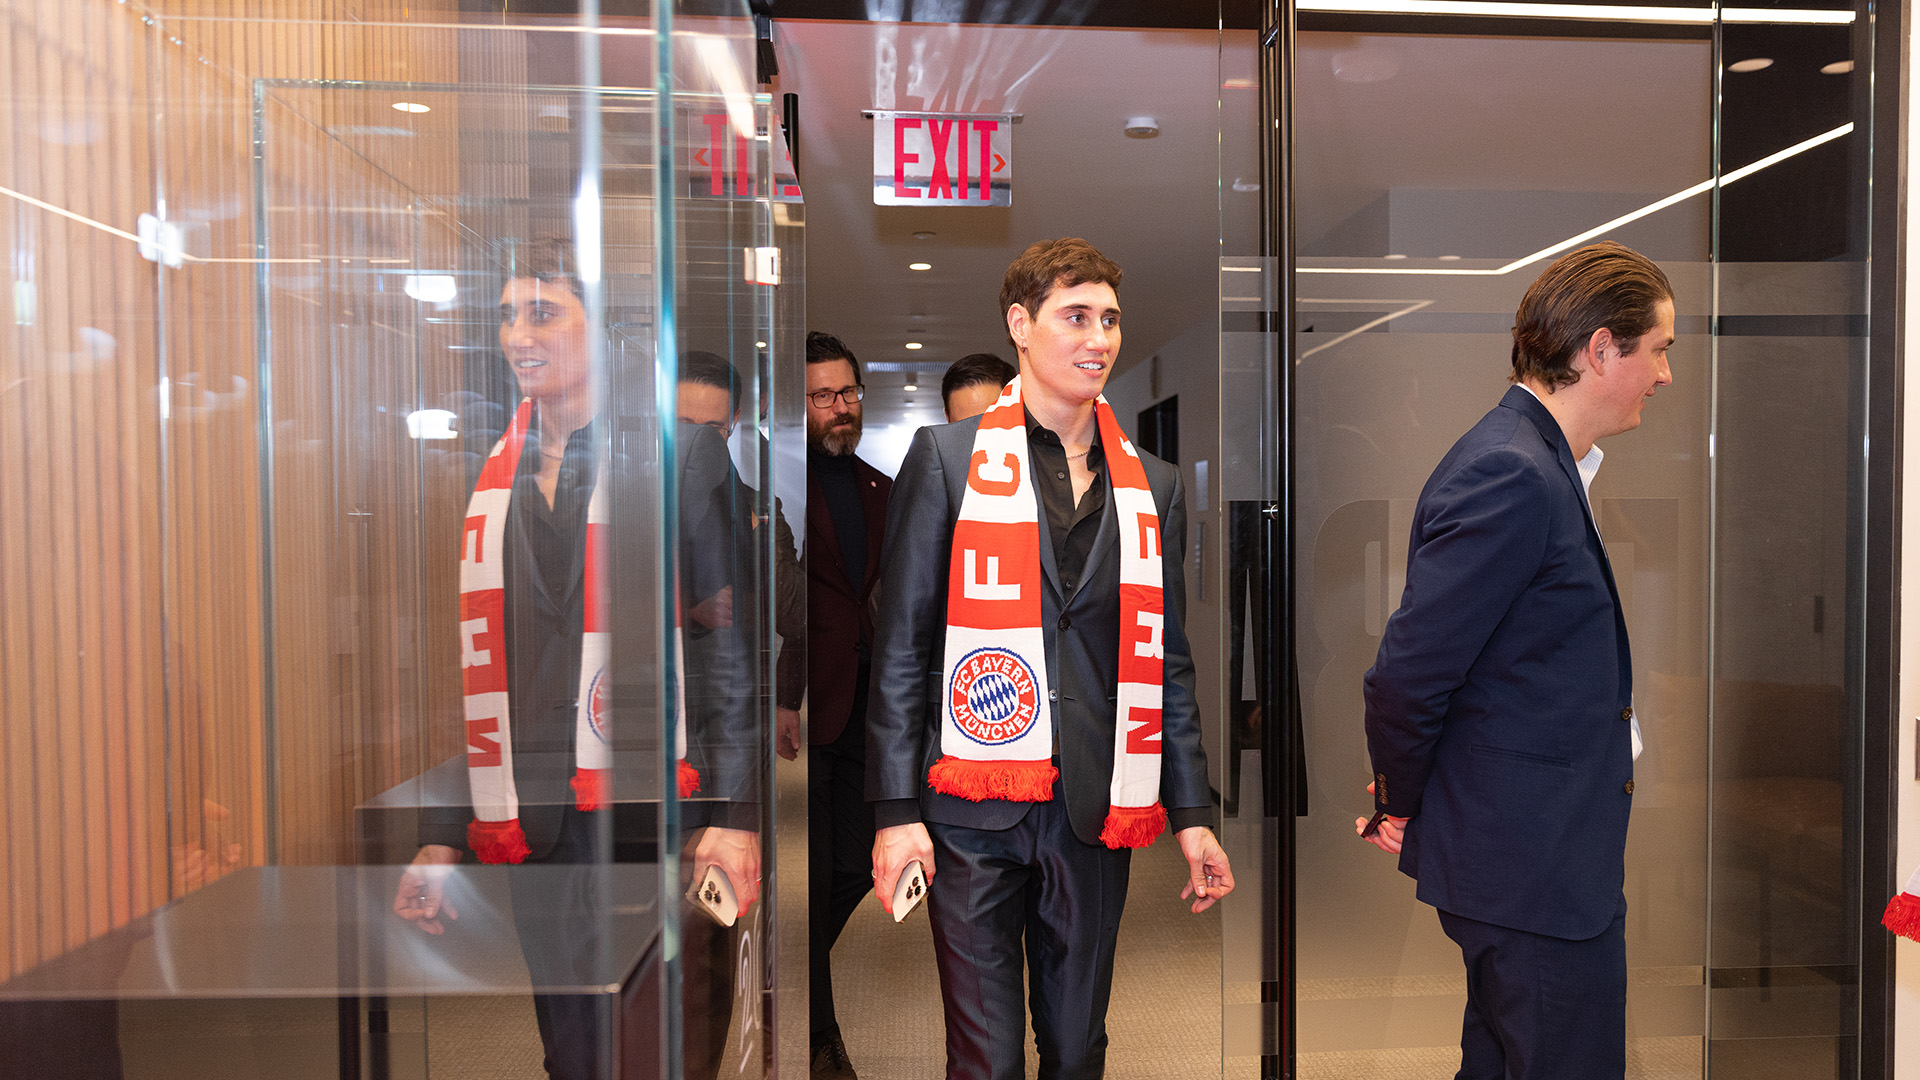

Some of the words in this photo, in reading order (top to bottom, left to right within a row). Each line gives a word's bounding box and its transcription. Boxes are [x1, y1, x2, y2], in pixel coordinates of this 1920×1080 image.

[894, 118, 998, 200] EXIT
[955, 669, 971, 696] FC
[970, 656, 1031, 695] BAYERN
